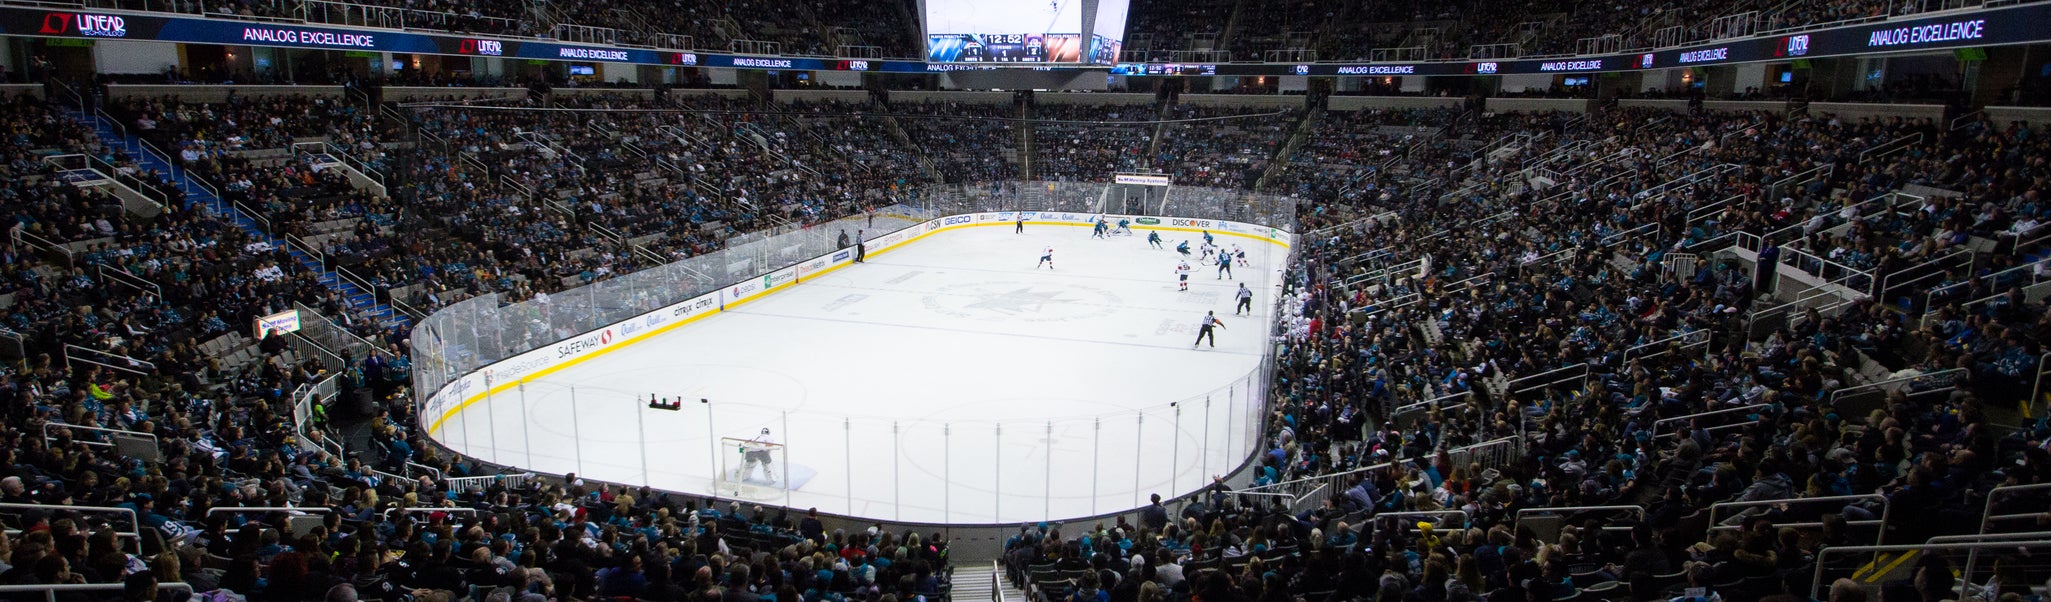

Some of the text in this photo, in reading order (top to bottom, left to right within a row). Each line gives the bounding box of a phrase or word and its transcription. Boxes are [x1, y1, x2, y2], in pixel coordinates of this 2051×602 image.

[77, 14, 126, 32] LINEAR
[244, 28, 374, 47] ANALOG EXCELLENCE
[1868, 20, 1984, 46] ANALOG EXCELLENCE
[478, 40, 501, 51] LINEAR
[1788, 35, 1809, 51] LINEAR
[559, 48, 628, 60] ANALOG EXCELLENCE
[1679, 48, 1727, 63] ANALOG EXCELLENCE
[755, 60, 791, 68] EXCELLENCE
[1338, 66, 1413, 74] ANALOG EXCELLENCE
[1541, 60, 1601, 71] ANALOG EXCELLENCE
[945, 216, 970, 225] GEICO
[1173, 219, 1210, 228] DISCOVER
[558, 335, 600, 359] SAFEWAY
[160, 520, 178, 535] 19
